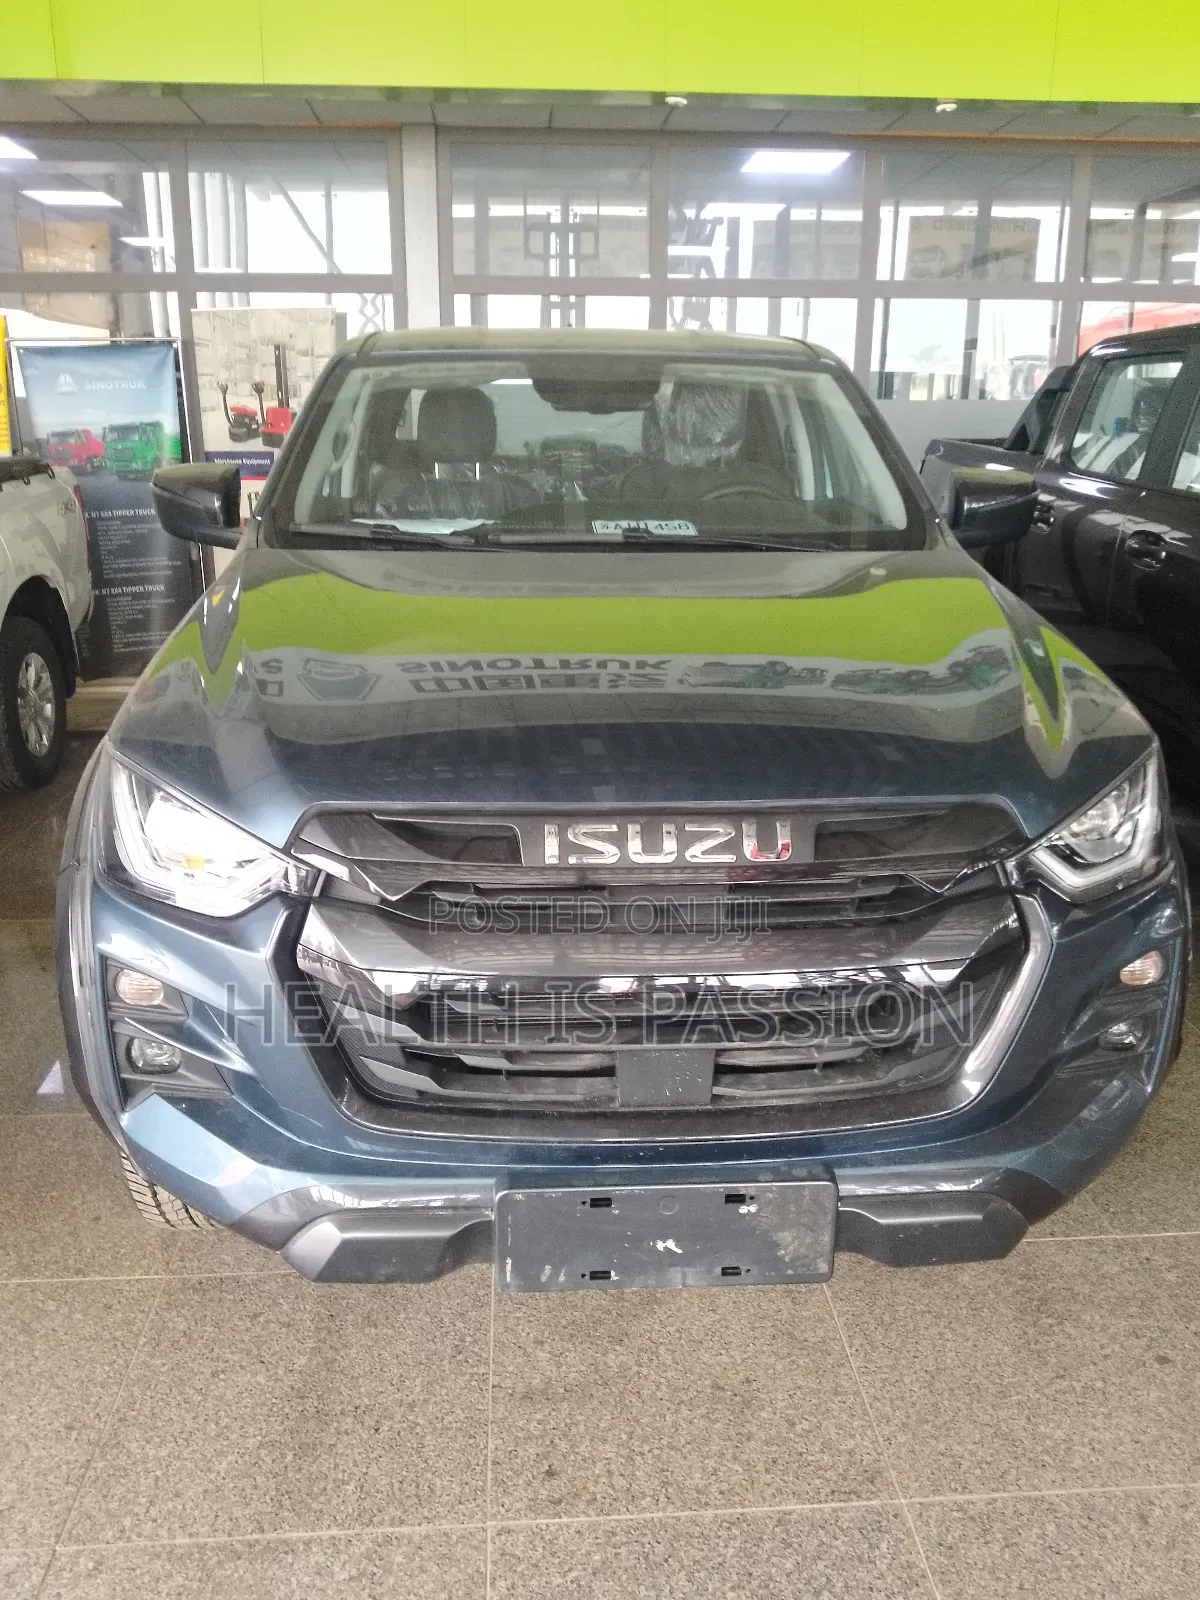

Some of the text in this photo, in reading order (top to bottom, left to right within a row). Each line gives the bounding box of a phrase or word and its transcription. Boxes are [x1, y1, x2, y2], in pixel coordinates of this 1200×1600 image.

[84, 379, 146, 390] SINOTRUK
[112, 509, 135, 517] TIPPER
[135, 508, 156, 516] TRUCK
[122, 586, 144, 594] TIPPER
[145, 584, 165, 592] TRUCK
[544, 818, 792, 864] ISUZU
